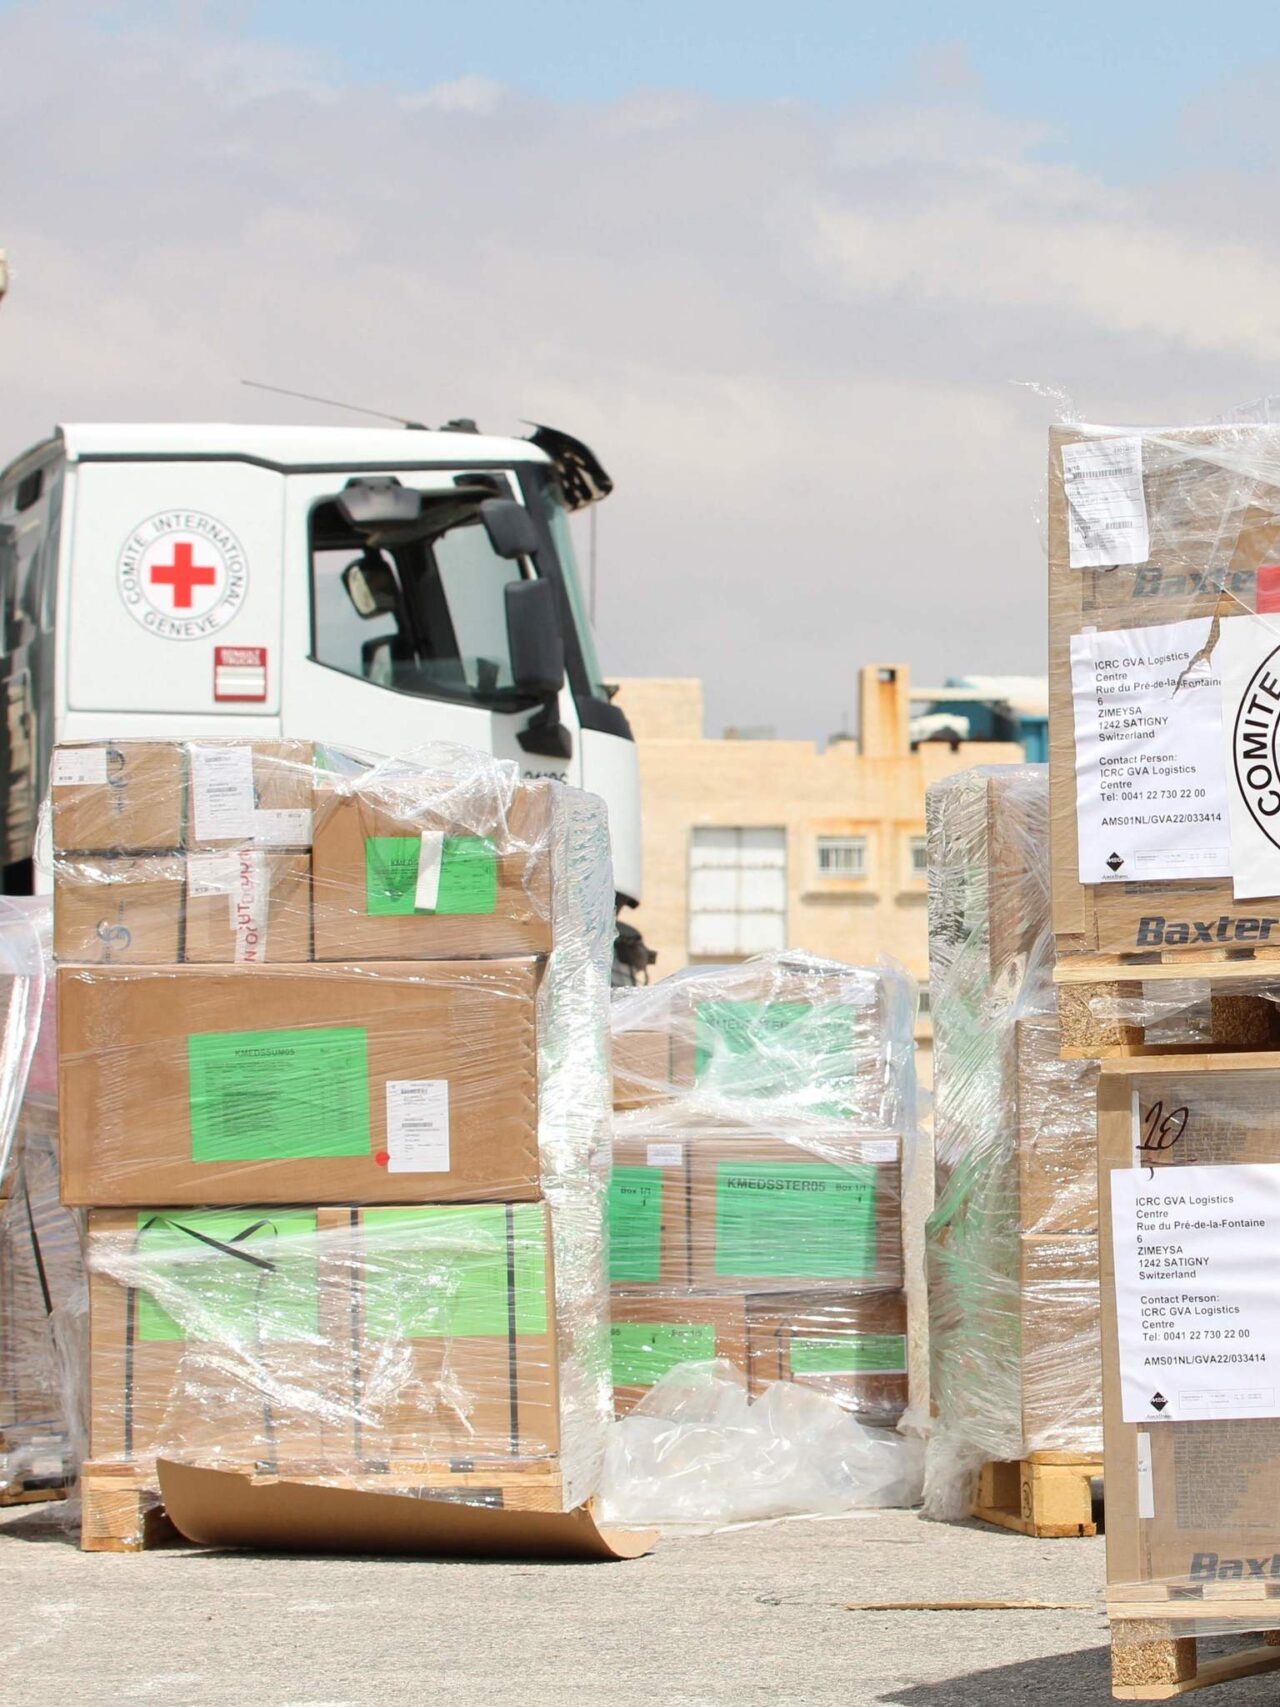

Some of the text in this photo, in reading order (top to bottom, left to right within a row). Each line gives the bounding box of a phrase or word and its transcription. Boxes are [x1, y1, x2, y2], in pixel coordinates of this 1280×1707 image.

[122, 513, 244, 608] COMITE INTERNATIONAL
[143, 610, 220, 637] GENEVE
[1094, 651, 1190, 670] ICRC GVA Logistics
[1095, 672, 1128, 682] Centre
[1096, 685, 1115, 695] Rue
[1118, 682, 1131, 693] du
[1097, 697, 1104, 706] 6
[1098, 706, 1143, 718] ZIMEYSA
[1099, 716, 1169, 730] 1242 SATIGNY
[1098, 730, 1156, 742] Switzerland
[1099, 754, 1178, 766] Contact Person:
[1100, 765, 1197, 778] ICRC GVA Logistics
[1100, 780, 1133, 790] Centre
[1100, 788, 1206, 802] Tel: 0041 22 730 22 00
[1101, 812, 1222, 827] AMS01NL/GVA22/033414
[1136, 915, 1280, 948] Baxter
[1136, 1194, 1235, 1207] ICRC GVA Logistics
[1136, 1209, 1169, 1219] Centre
[1136, 1218, 1266, 1231] Rue du Pré-de-la-Fontaine
[1137, 1235, 1143, 1244] 6
[1137, 1246, 1183, 1256] ZIMEYSA
[1138, 1256, 1210, 1268] 1242 SATIGNY
[1138, 1270, 1197, 1280] Switzerland
[1140, 1293, 1220, 1305] Contact Person:
[1141, 1305, 1240, 1317] ICRC GVA Logistics
[1142, 1320, 1175, 1329] Centre
[1143, 1328, 1250, 1342] Tel: 0041 22 730 22 00
[1144, 1353, 1266, 1366] AMS01NL/GVA22/033414
